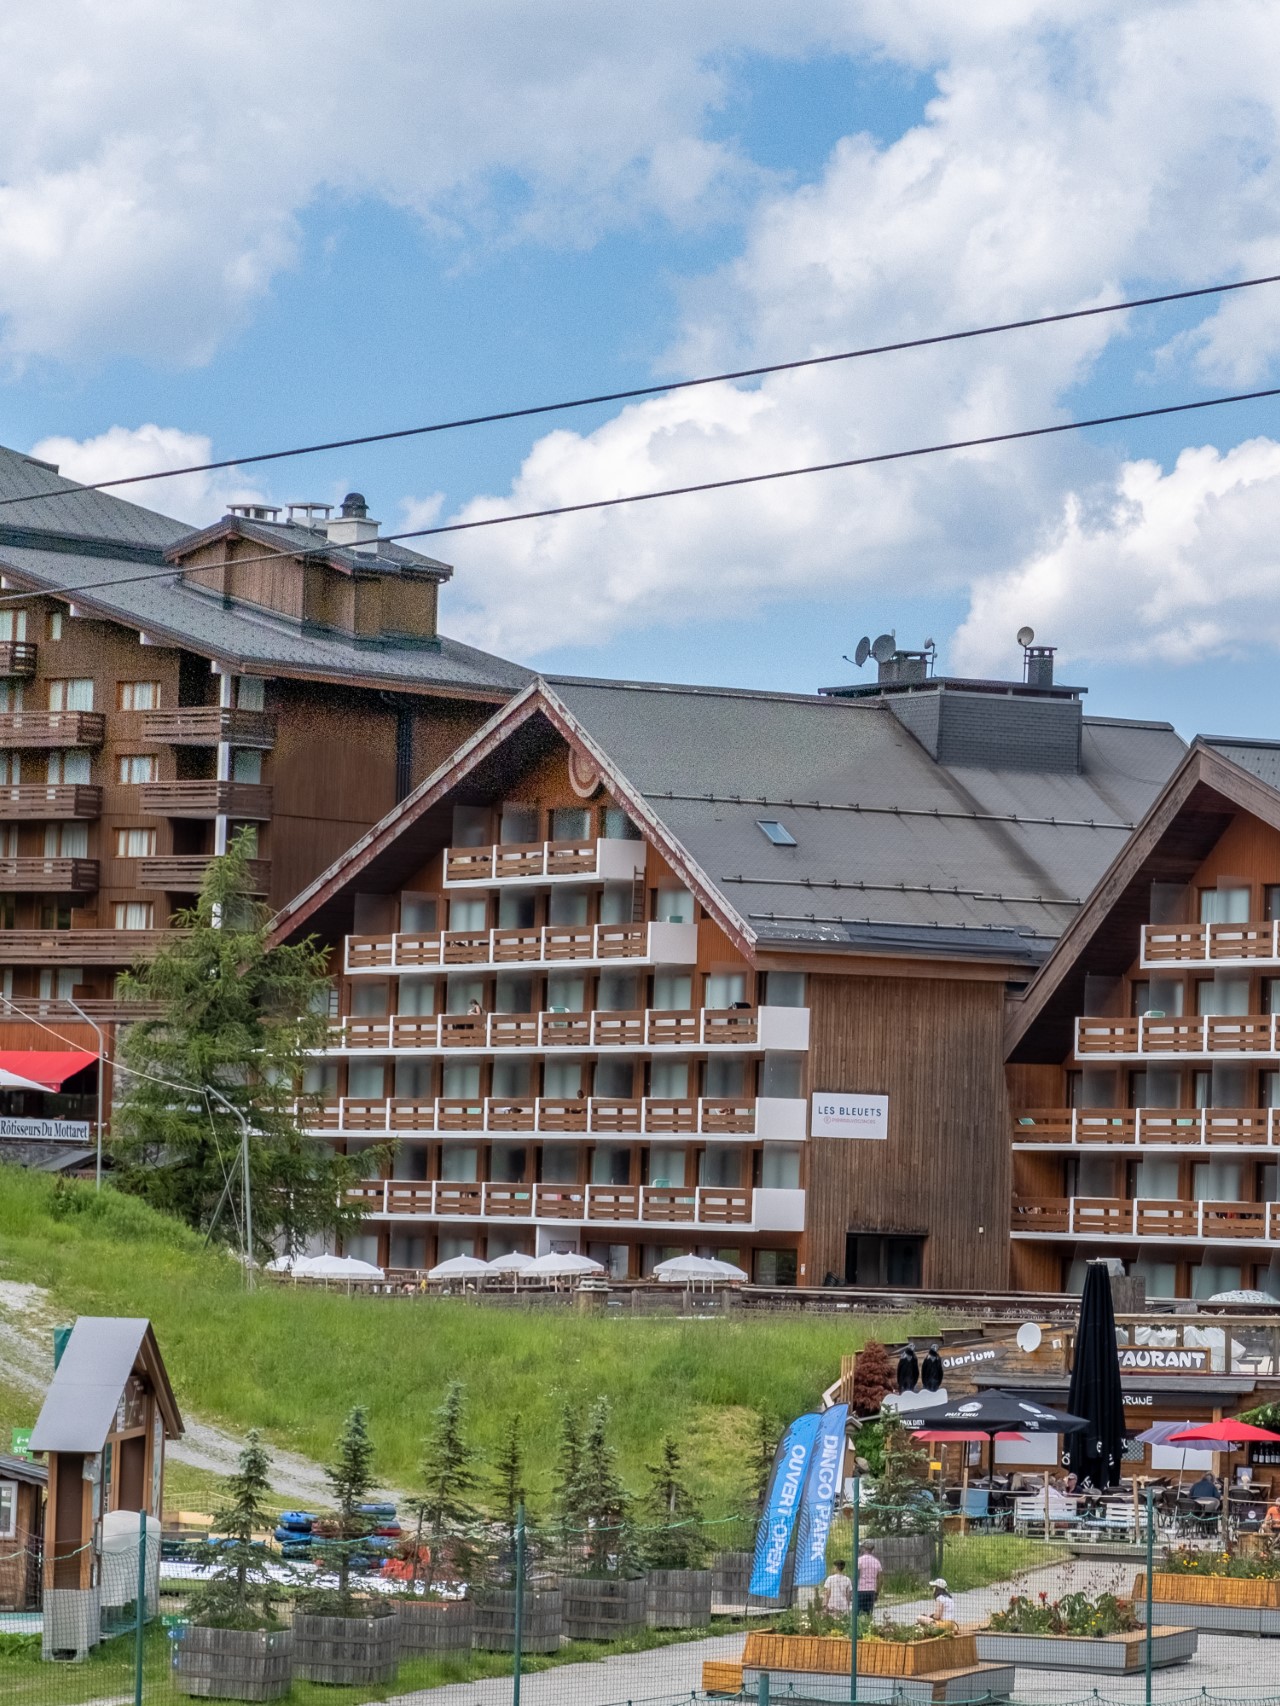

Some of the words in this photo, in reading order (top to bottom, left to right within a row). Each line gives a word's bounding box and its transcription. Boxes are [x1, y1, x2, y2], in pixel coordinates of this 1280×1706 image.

[0, 1120, 41, 1136] Rôtisseurs
[41, 1122, 52, 1137] Du
[54, 1123, 87, 1138] Mottaret
[818, 1106, 835, 1115] LES
[839, 1107, 882, 1117] BLEUETS
[817, 1435, 839, 1500] DINGO
[811, 1504, 831, 1561] PARK
